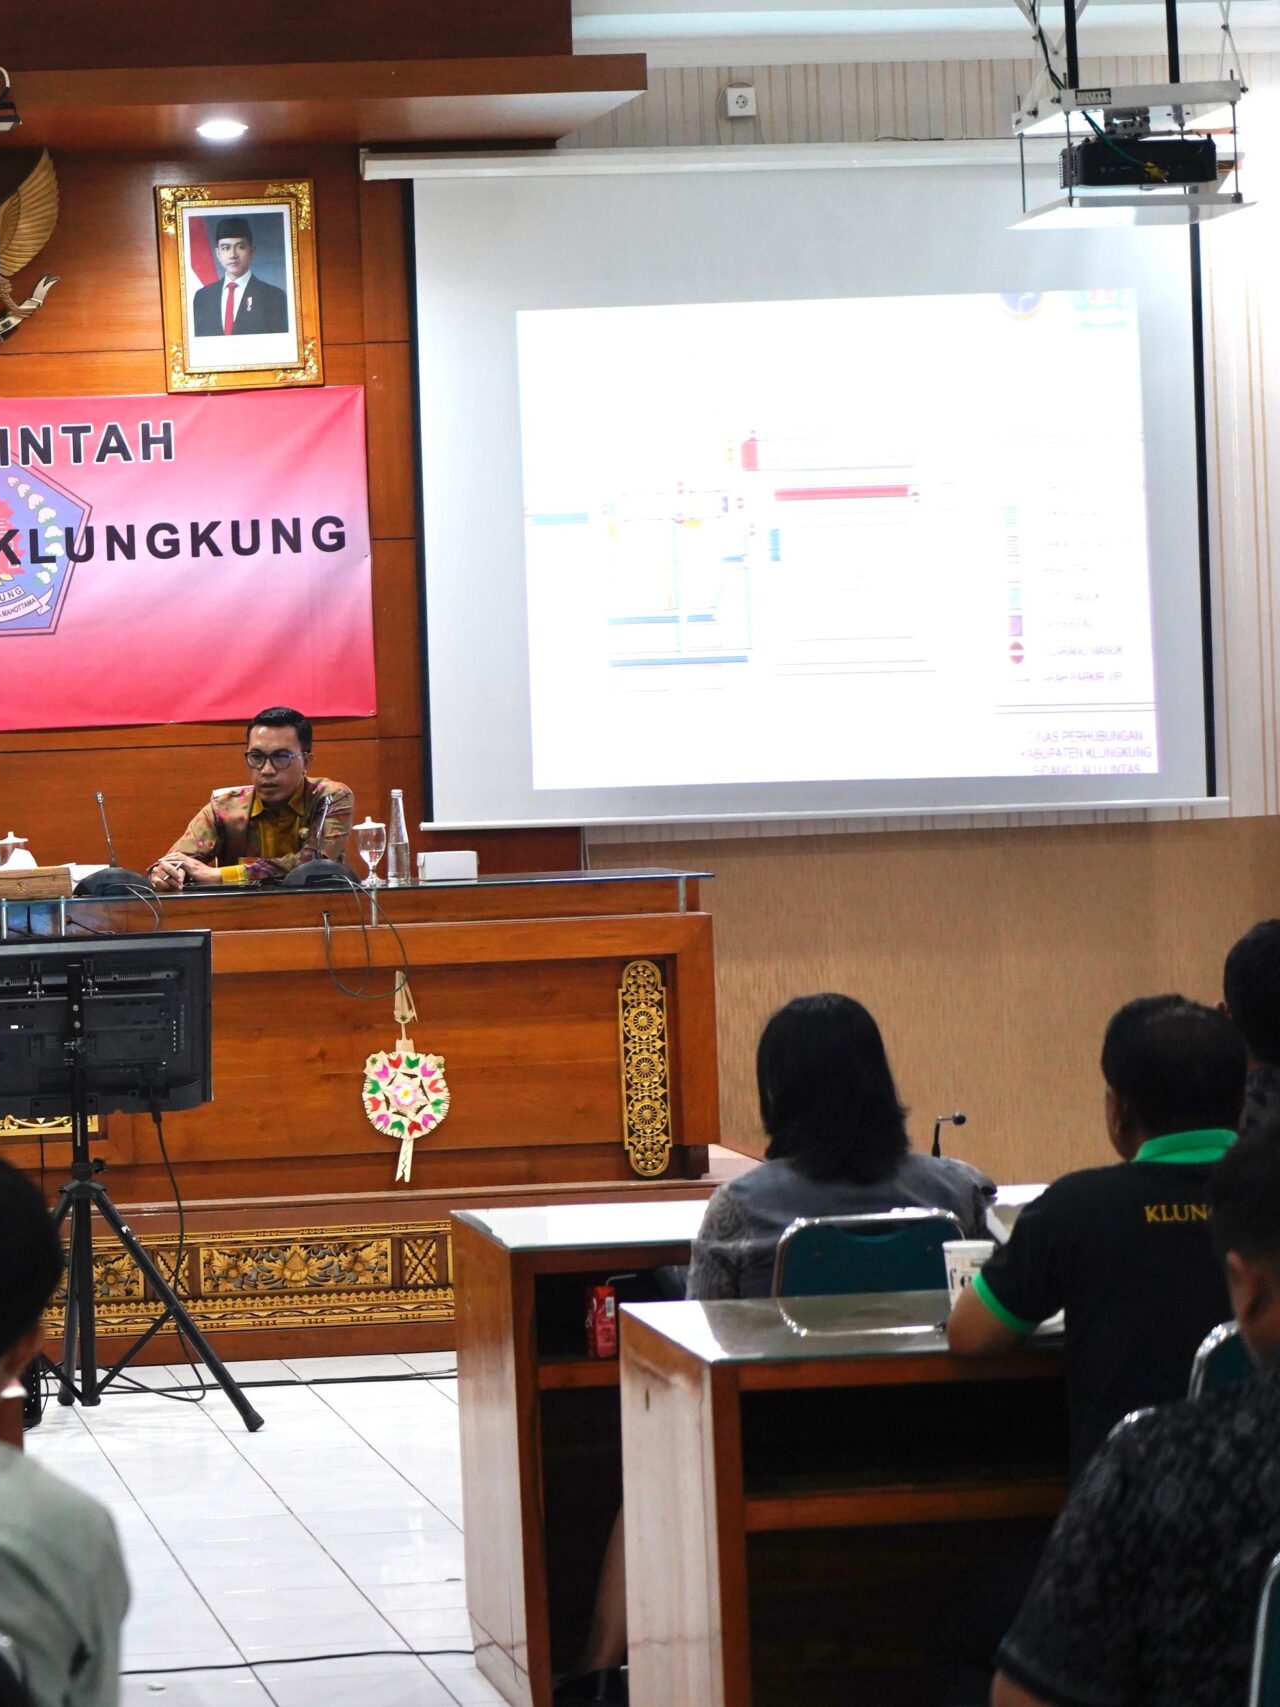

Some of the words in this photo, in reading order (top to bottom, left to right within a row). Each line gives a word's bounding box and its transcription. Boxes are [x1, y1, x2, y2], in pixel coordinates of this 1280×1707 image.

[1, 597, 37, 616] MAHOTTAMA
[1062, 730, 1143, 743] PERHUBUNGAN
[1086, 746, 1152, 759] KLUNGKUNG
[1144, 1204, 1212, 1223] KLUN
